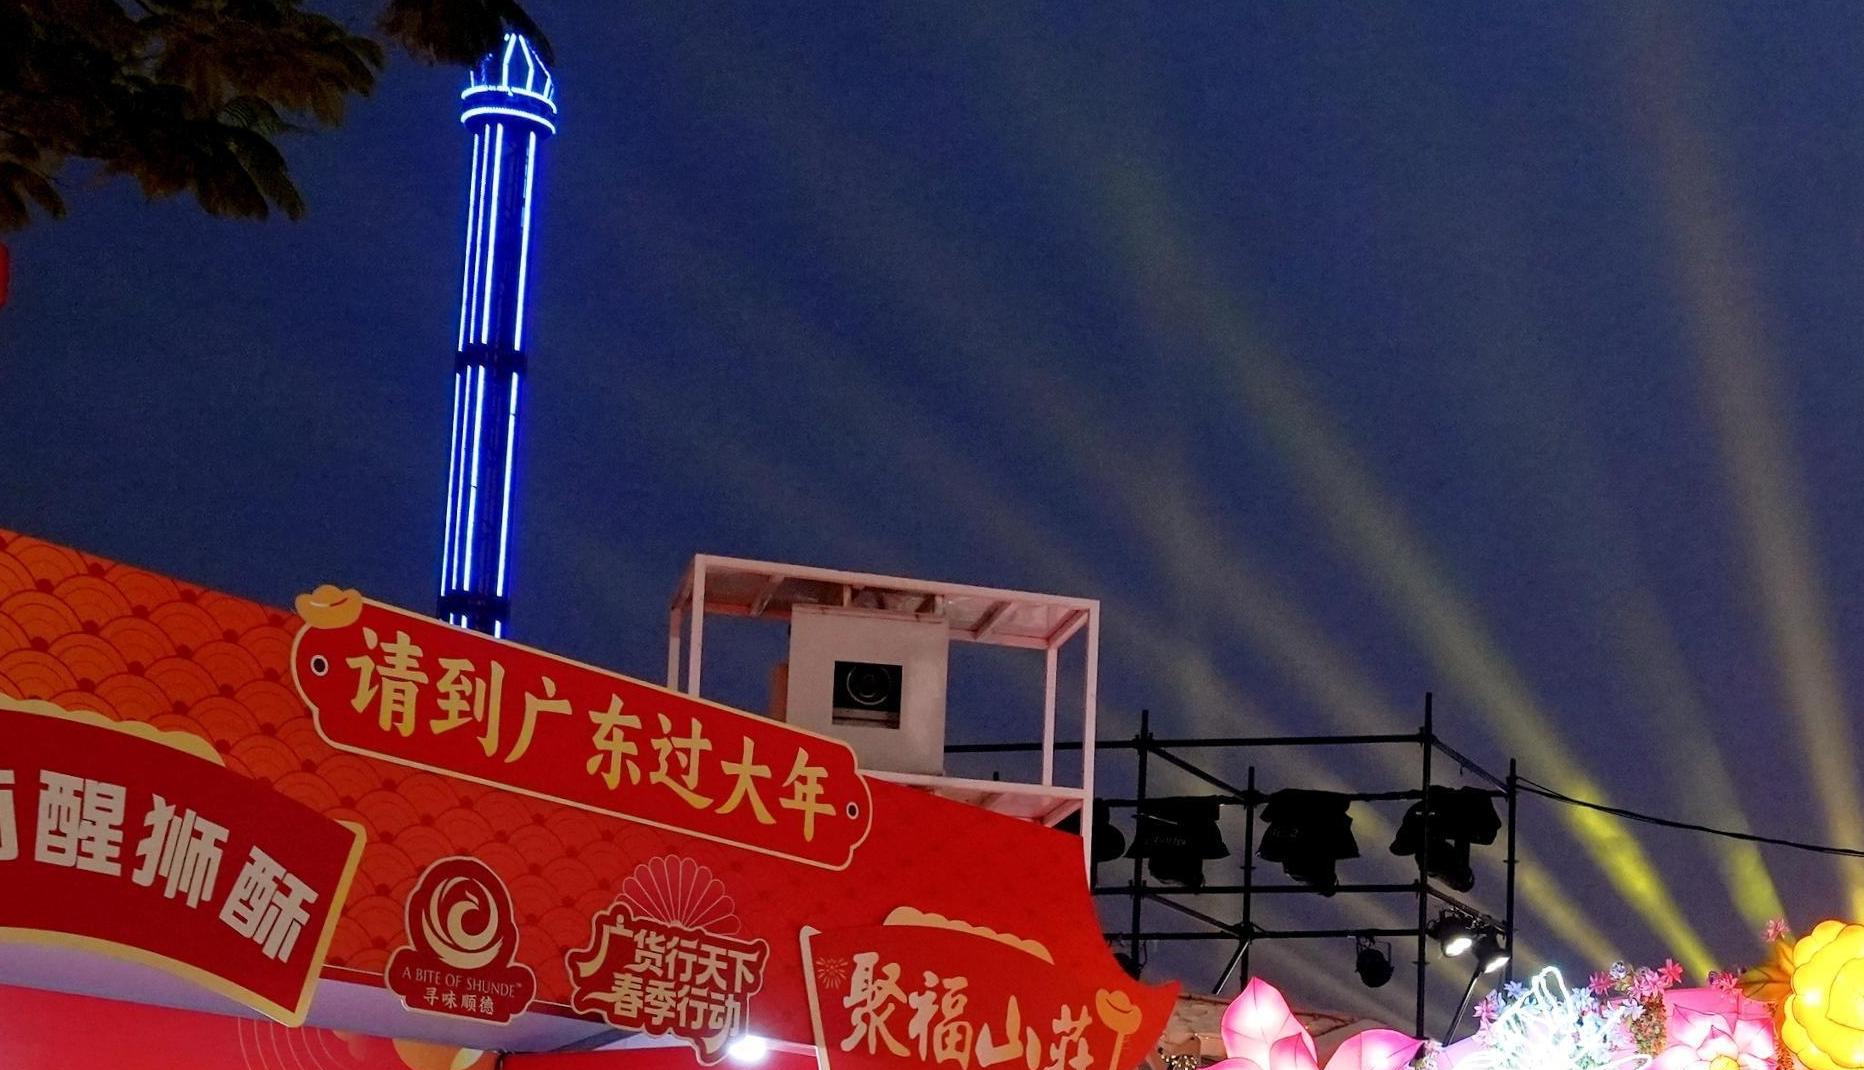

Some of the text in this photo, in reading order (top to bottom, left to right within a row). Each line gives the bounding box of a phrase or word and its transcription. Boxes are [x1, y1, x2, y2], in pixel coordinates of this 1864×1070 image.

[345, 625, 838, 842] 请到广东过大年
[402, 967, 411, 979] A
[416, 968, 440, 985] BITE
[445, 973, 462, 988] OF
[576, 914, 760, 994] 广货行天下
[423, 987, 494, 1015] 寻味顺德
[581, 972, 741, 1054] 春季行动
